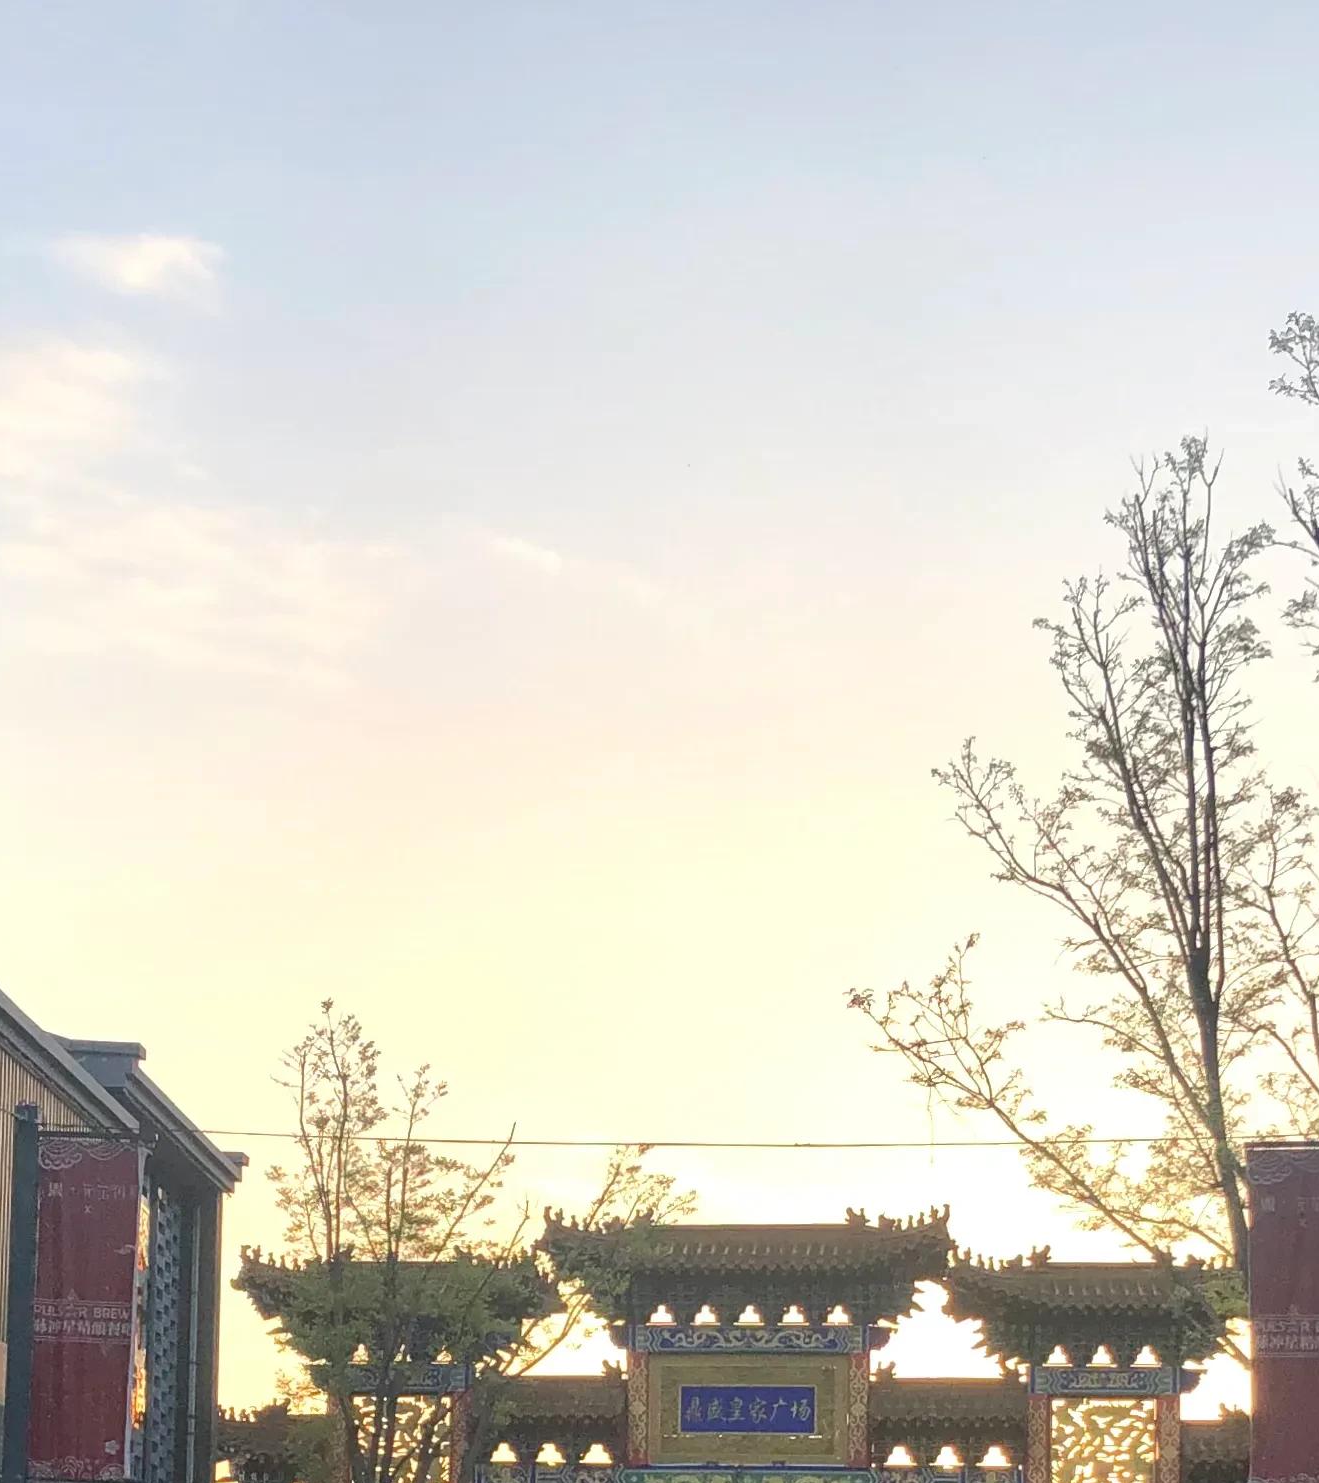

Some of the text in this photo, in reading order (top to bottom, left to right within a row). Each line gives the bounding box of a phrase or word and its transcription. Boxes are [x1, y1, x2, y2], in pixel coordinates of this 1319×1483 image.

[684, 1396, 811, 1425] 鼎盛皇家广场
